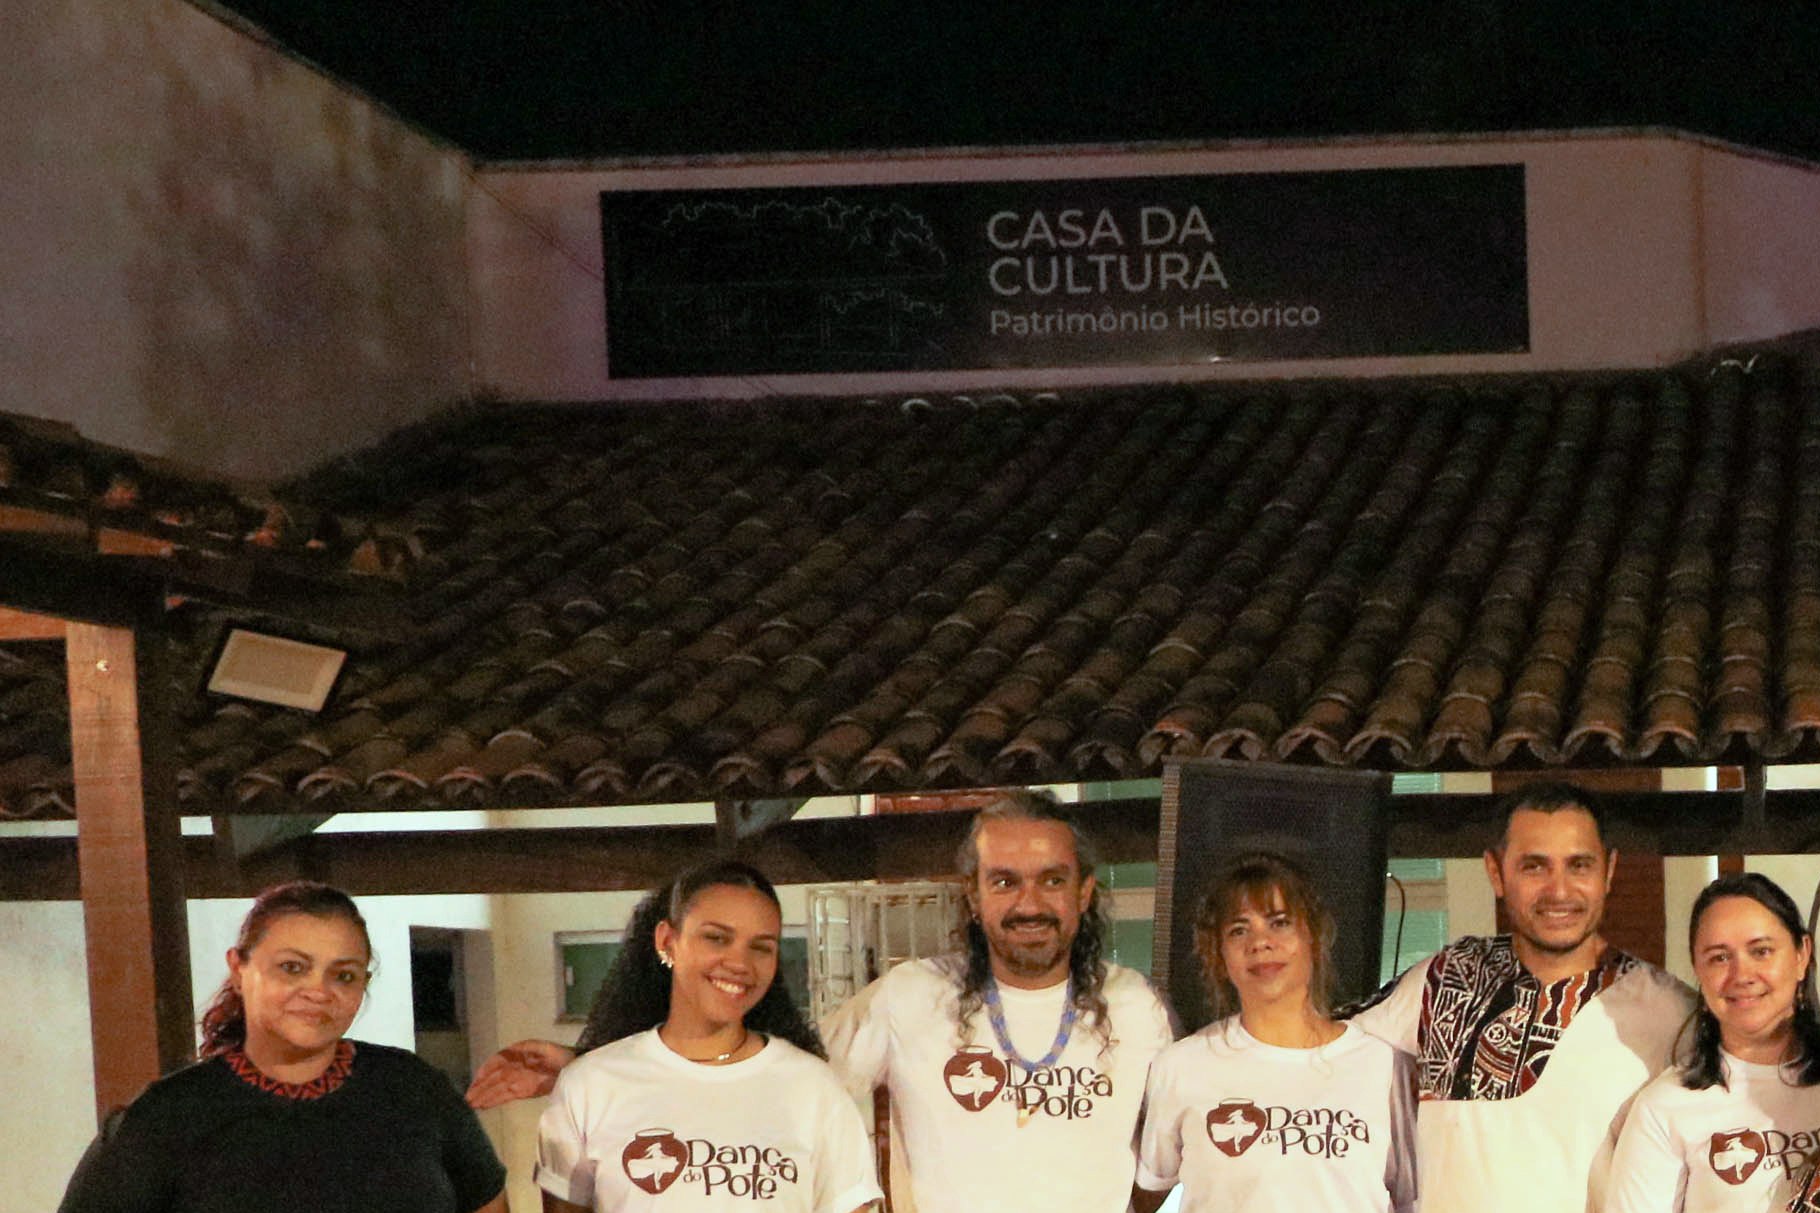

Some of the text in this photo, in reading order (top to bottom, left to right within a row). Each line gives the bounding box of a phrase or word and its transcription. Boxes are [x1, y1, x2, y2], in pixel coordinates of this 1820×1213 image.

[986, 205, 1215, 250] CASA DA
[988, 251, 1229, 296] CULTURA
[990, 302, 1321, 337] Patrimônio Histórico
[1005, 1058, 1113, 1097] Dança
[1020, 1085, 1093, 1120] Pote
[1261, 1126, 1349, 1159] do Pote
[1265, 1106, 1370, 1144] Dança
[686, 1139, 798, 1184] Dança
[1763, 1157, 1781, 1170] do
[683, 1164, 777, 1200] do Pote
